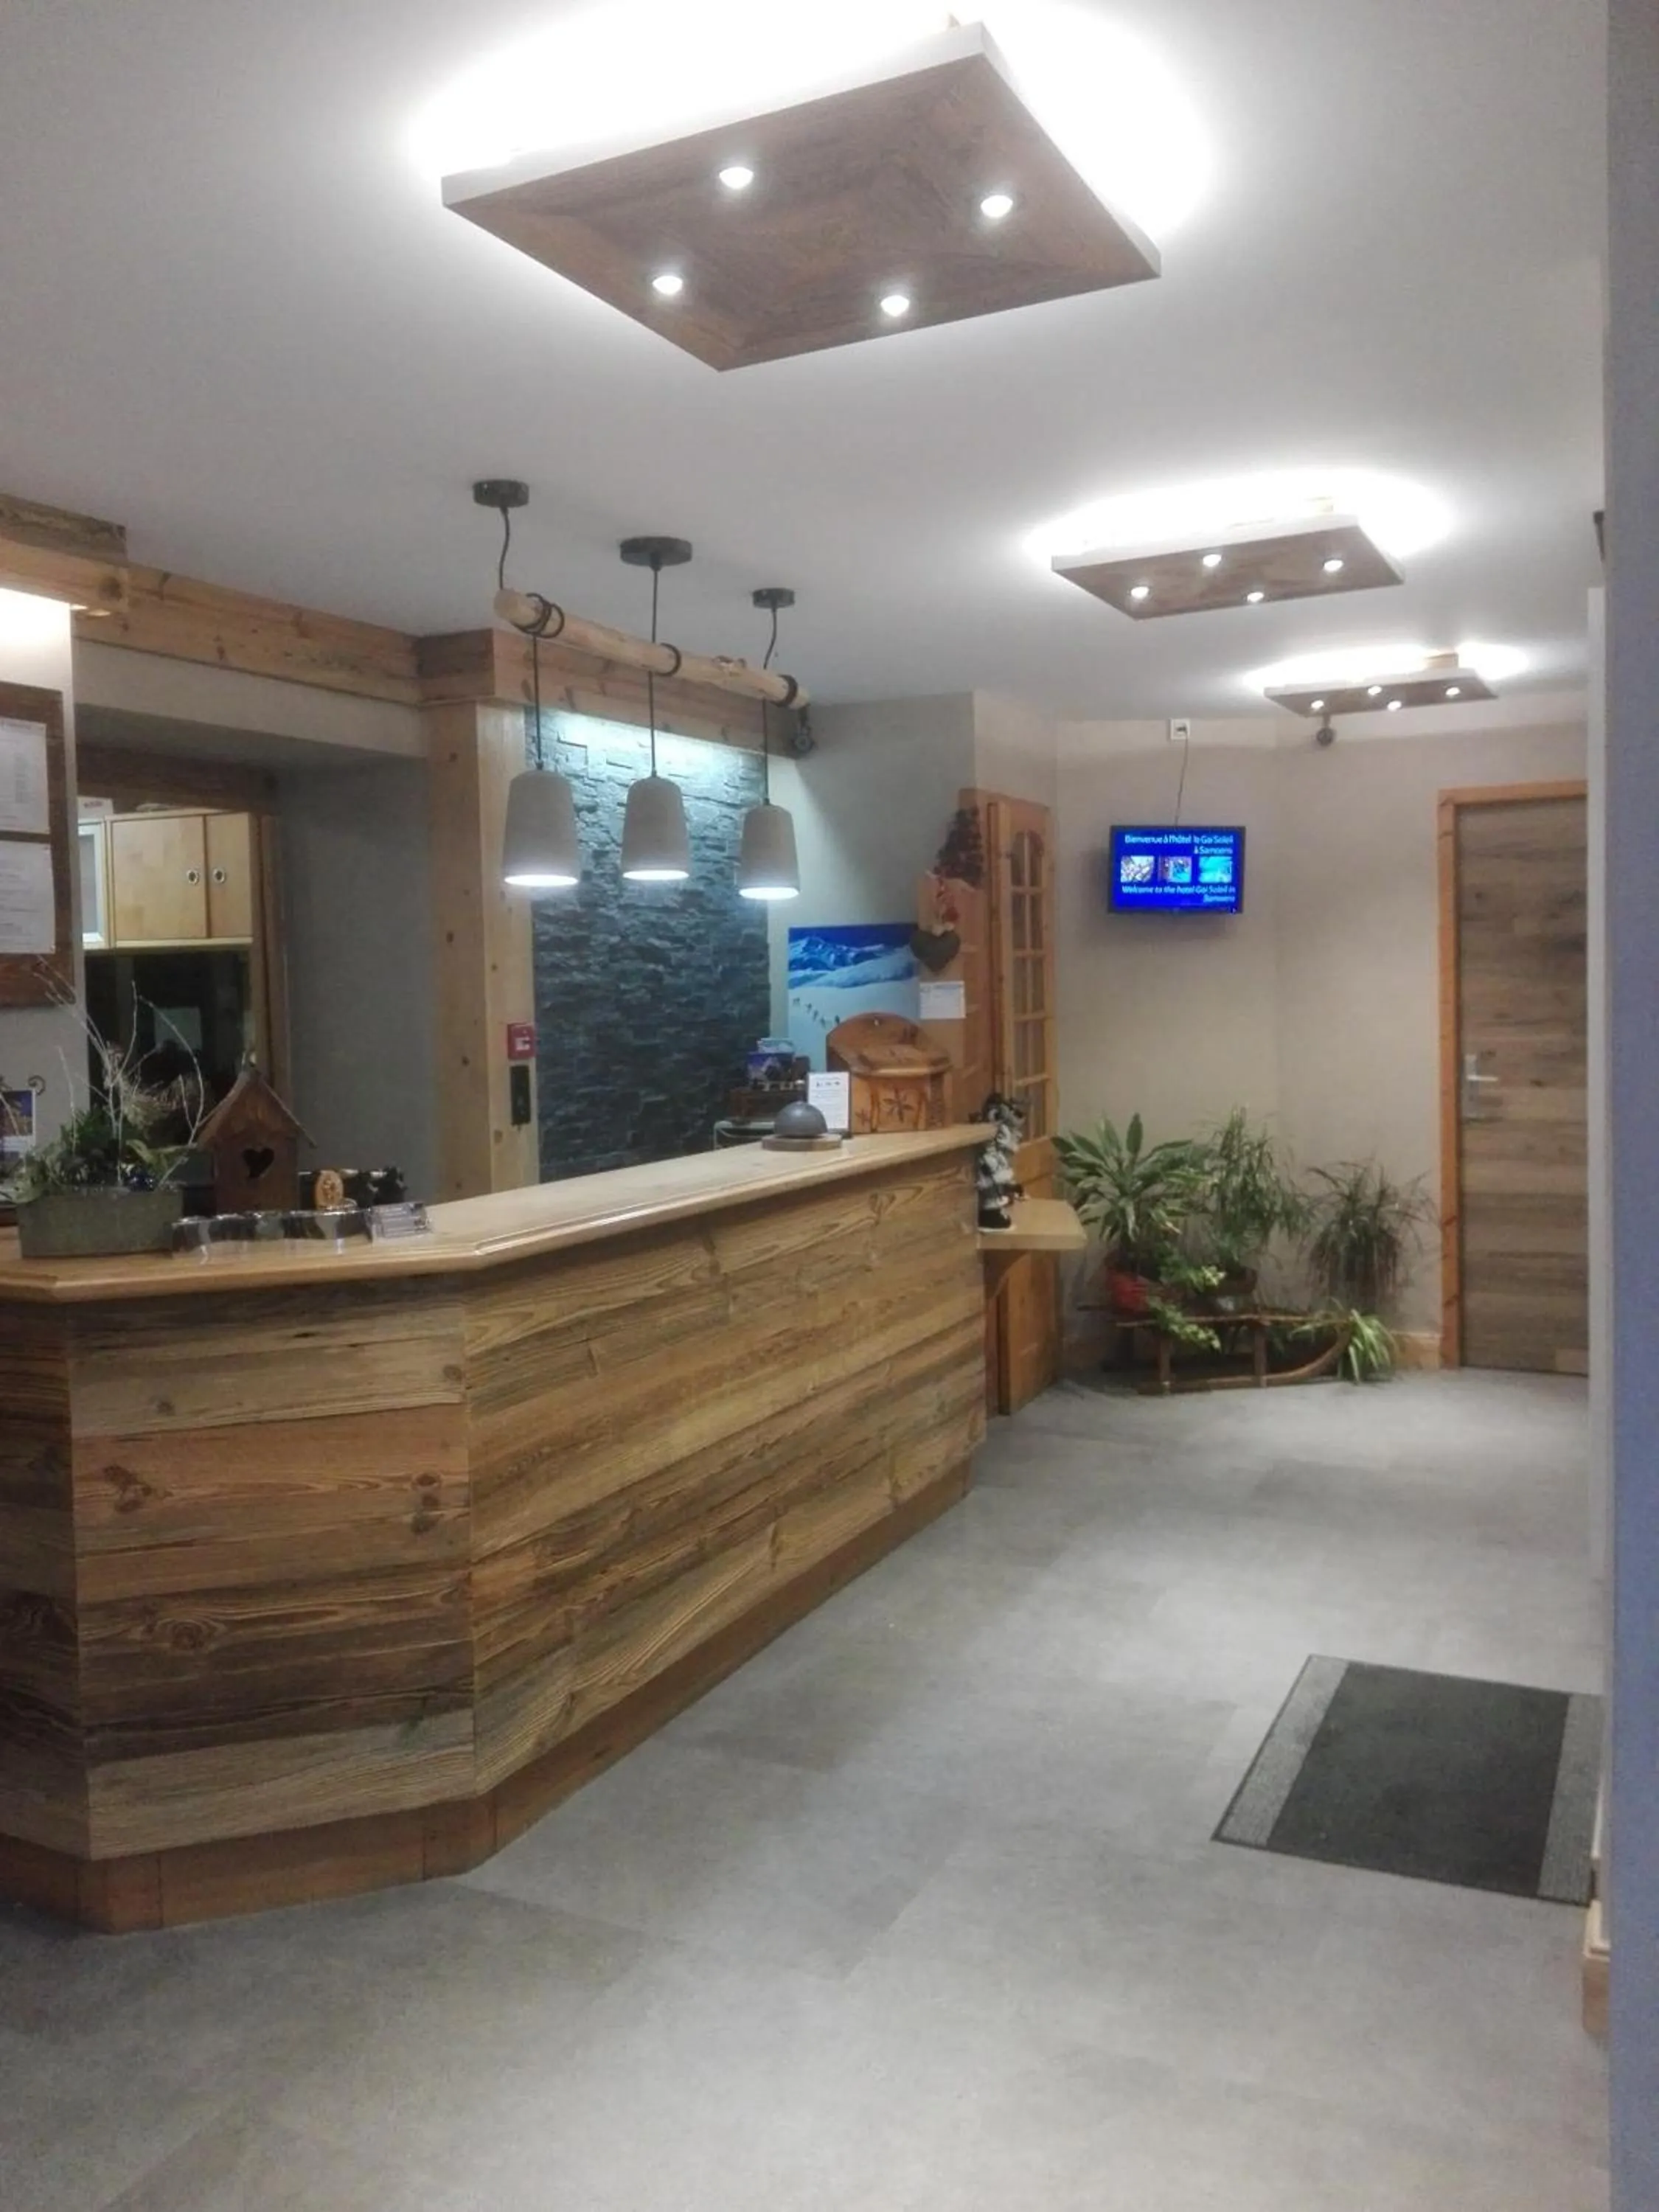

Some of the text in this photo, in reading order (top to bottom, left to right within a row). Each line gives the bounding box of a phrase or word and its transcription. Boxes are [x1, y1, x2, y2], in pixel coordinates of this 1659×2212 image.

[1124, 834, 1163, 844] Bienvenue
[1121, 885, 1153, 894] Welcome
[1164, 886, 1175, 894] the
